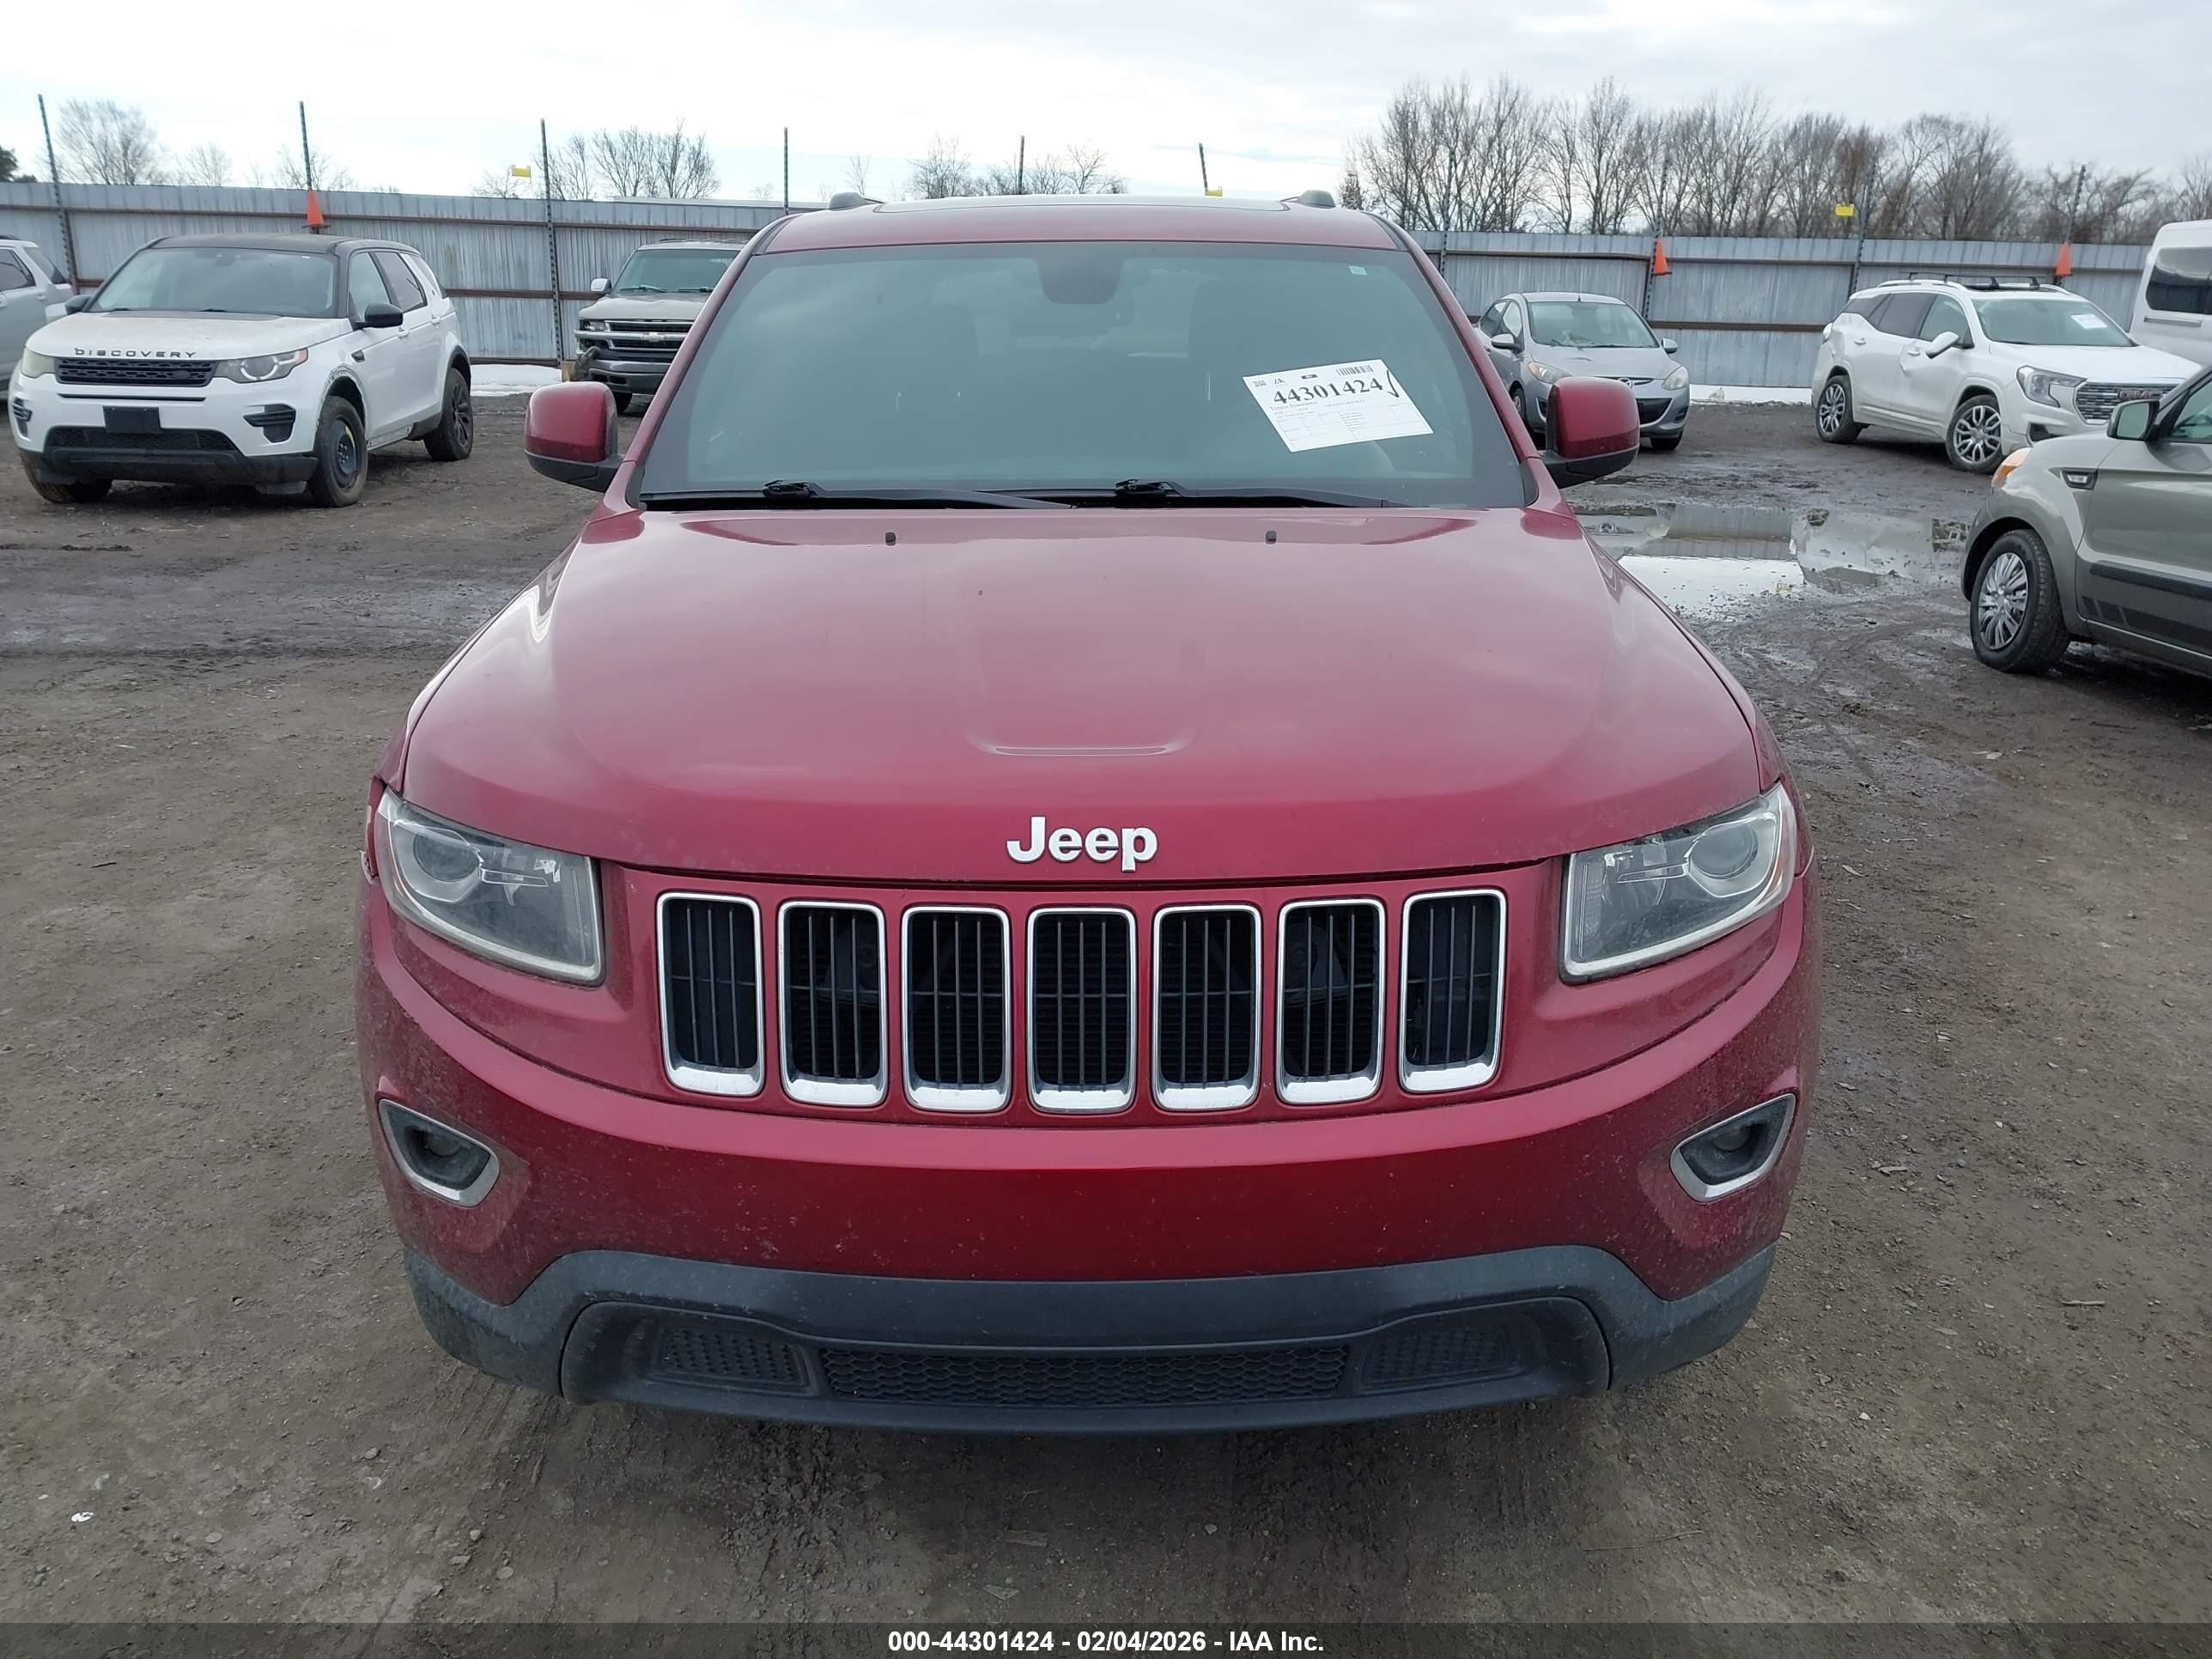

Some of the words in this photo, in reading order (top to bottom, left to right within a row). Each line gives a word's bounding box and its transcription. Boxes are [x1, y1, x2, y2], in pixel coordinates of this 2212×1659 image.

[74, 347, 198, 358] DISCOVERY
[1273, 377, 1384, 404] 44301424
[1006, 816, 1158, 872] Jeep
